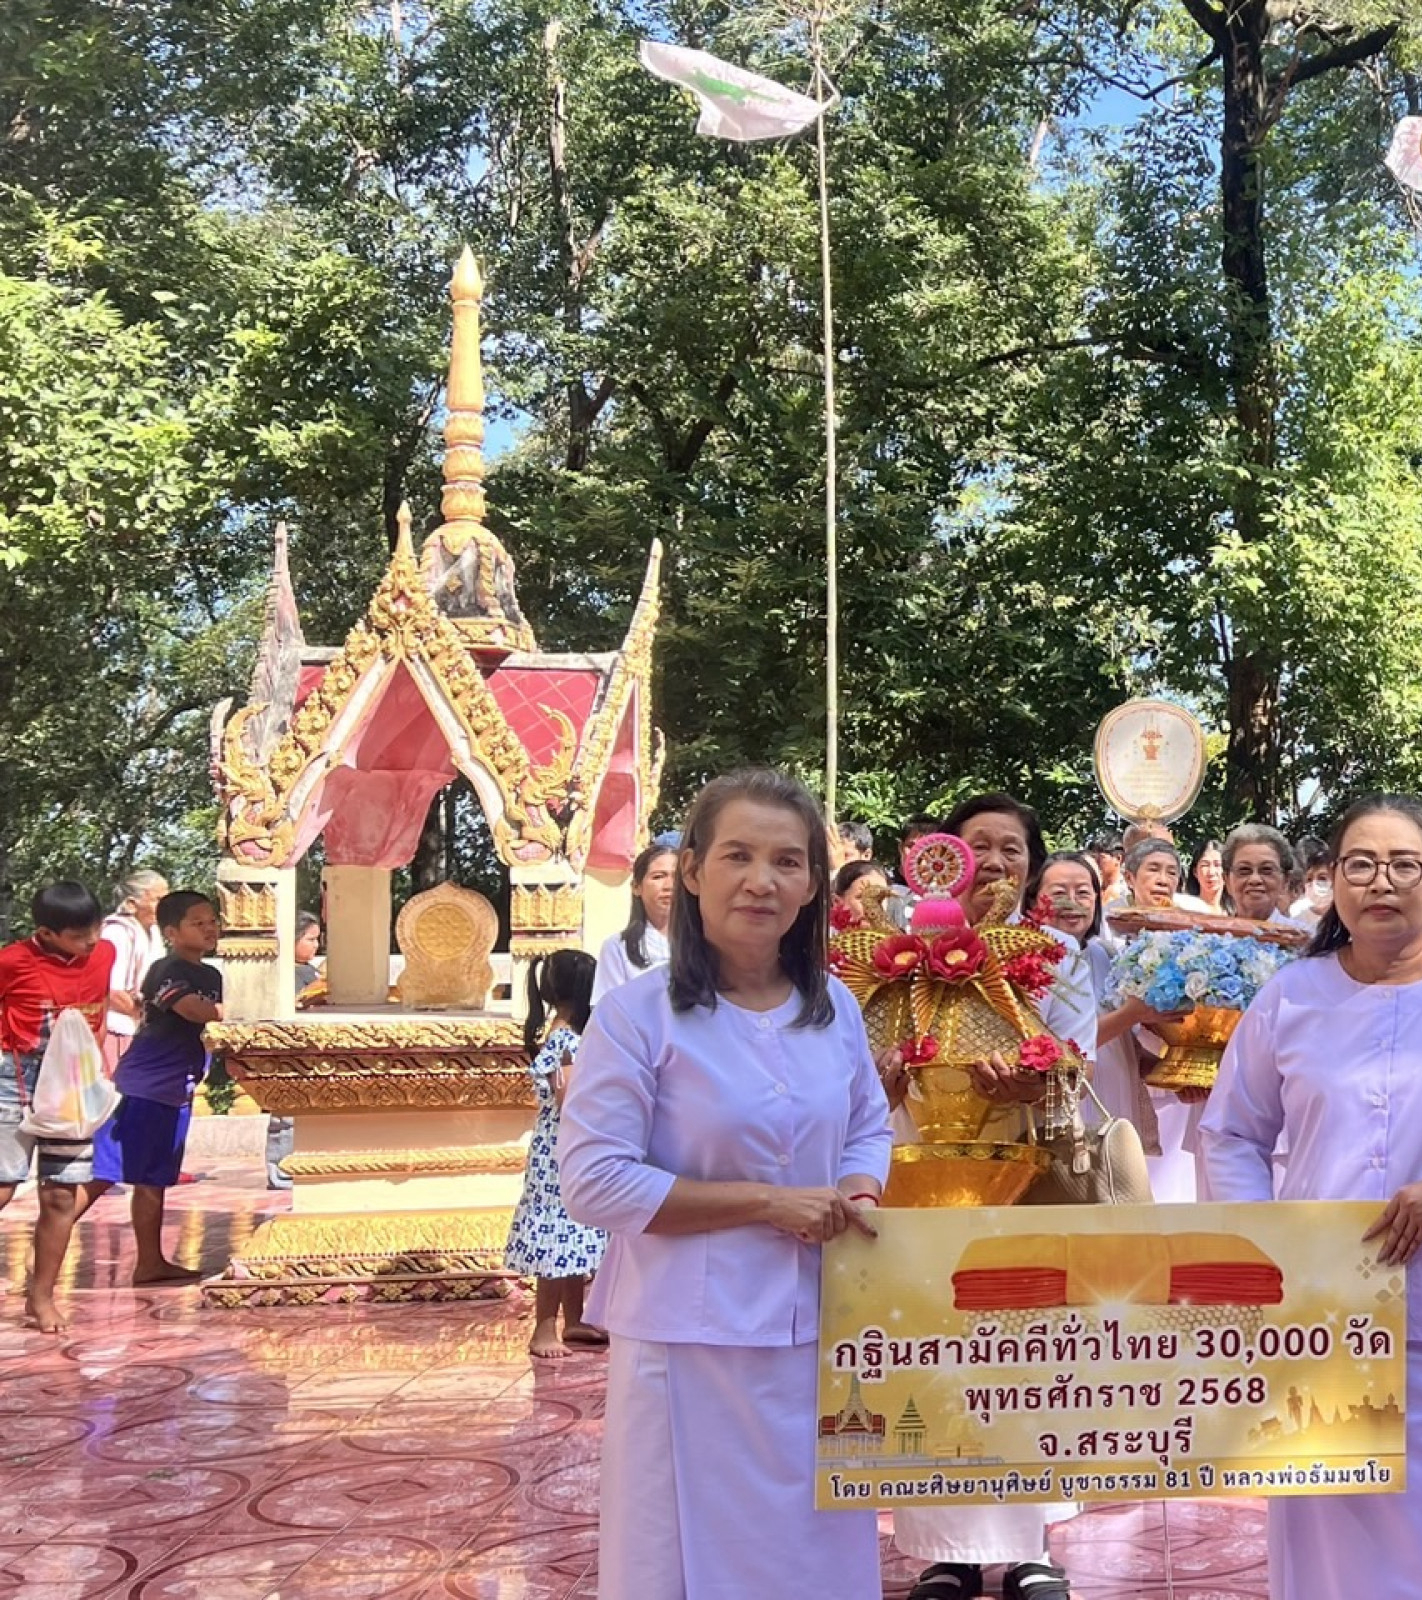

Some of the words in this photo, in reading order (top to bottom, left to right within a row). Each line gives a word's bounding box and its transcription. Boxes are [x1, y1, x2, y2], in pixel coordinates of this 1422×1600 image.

[835, 1313, 1178, 1380] กฐินสามัคคีทั่วไทย
[1195, 1326, 1330, 1364] 30,000
[1345, 1317, 1392, 1356] วัด
[964, 1373, 1163, 1424] พุทธศักราช
[1177, 1377, 1266, 1406] 2568
[1038, 1415, 1194, 1466] จ.สระบุรี
[830, 1474, 870, 1499] โดย
[879, 1468, 1053, 1500] คณะศิษยานุศิษย์
[1060, 1473, 1156, 1499] บูชาธรรม
[1165, 1470, 1191, 1488] 81
[1199, 1465, 1214, 1488] ปี
[1222, 1459, 1391, 1487] หลวงพ่อธัมมชโย
